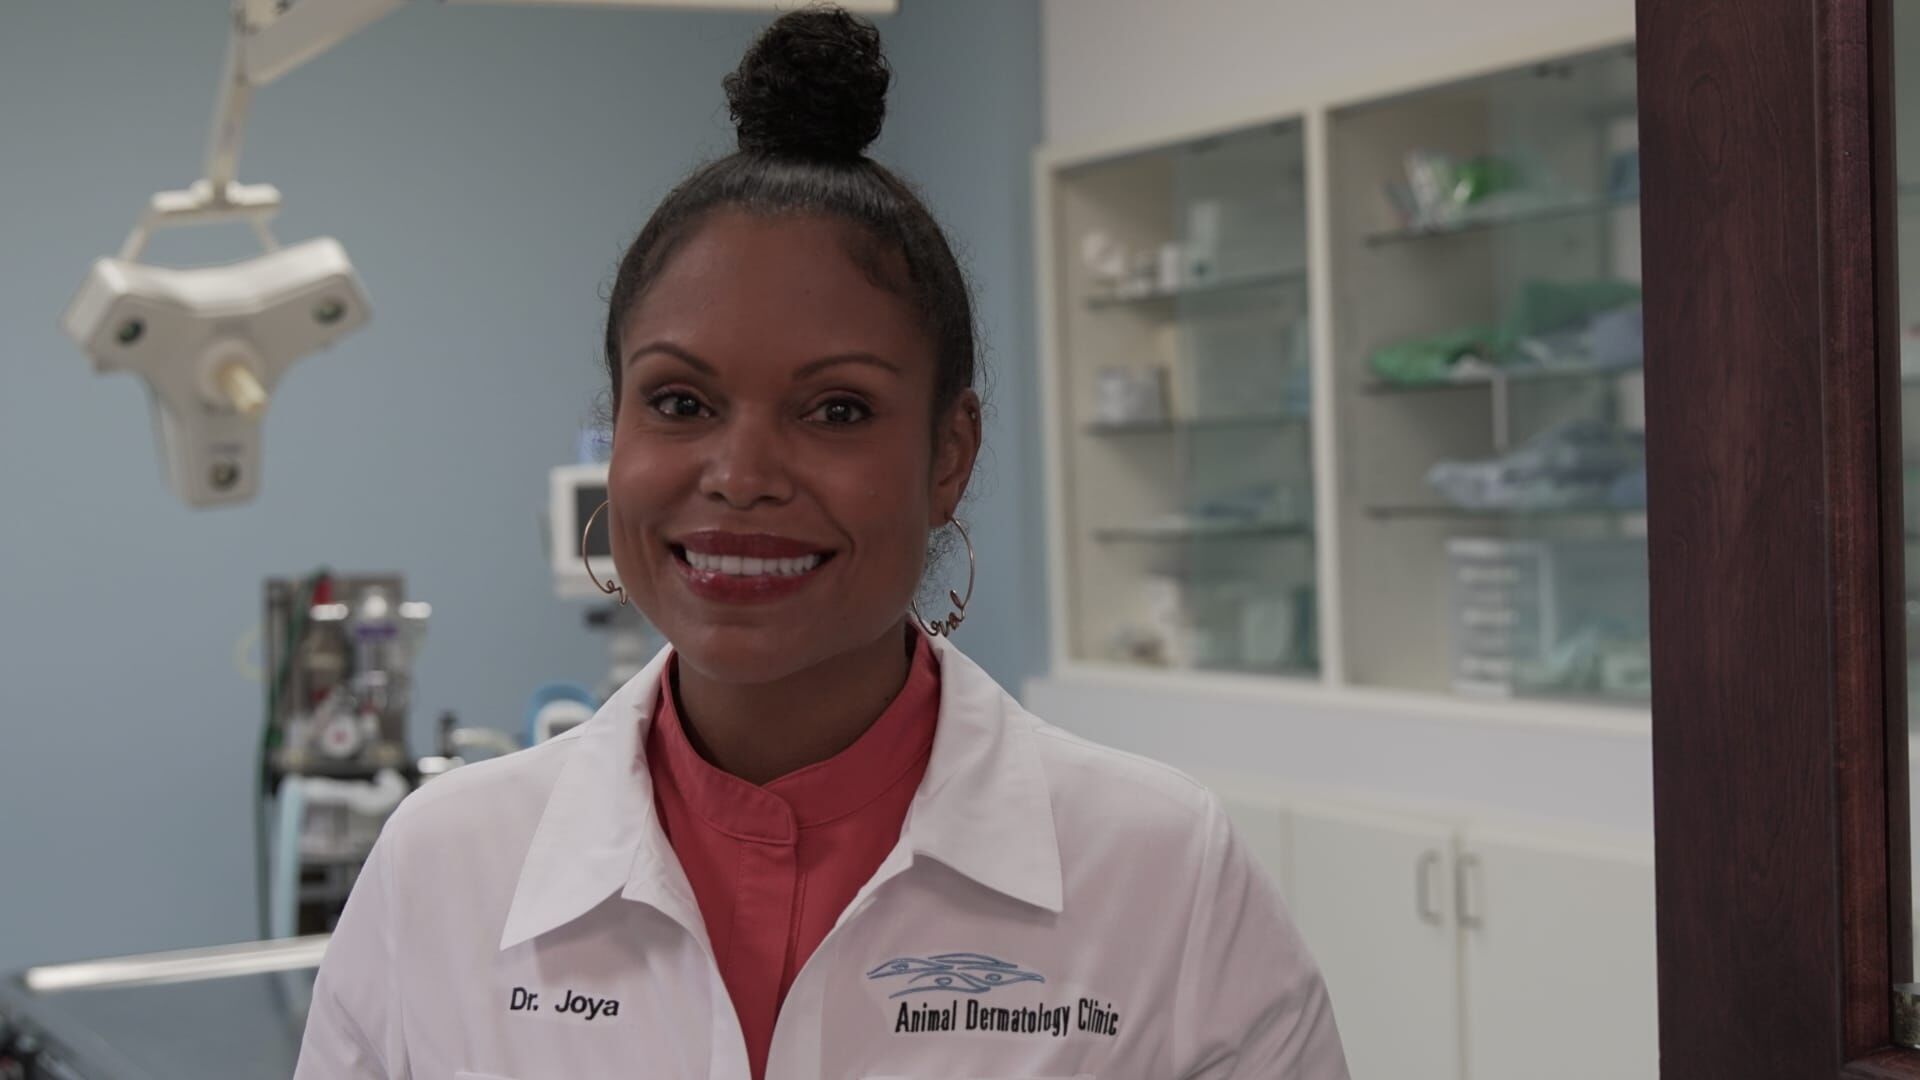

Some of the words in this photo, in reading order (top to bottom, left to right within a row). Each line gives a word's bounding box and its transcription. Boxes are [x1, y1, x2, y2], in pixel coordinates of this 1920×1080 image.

[510, 986, 539, 1011] Dr.
[554, 989, 620, 1021] Joya
[895, 1000, 957, 1033] Animal
[965, 999, 1070, 1037] Dermatology
[1077, 998, 1119, 1036] Clinic
